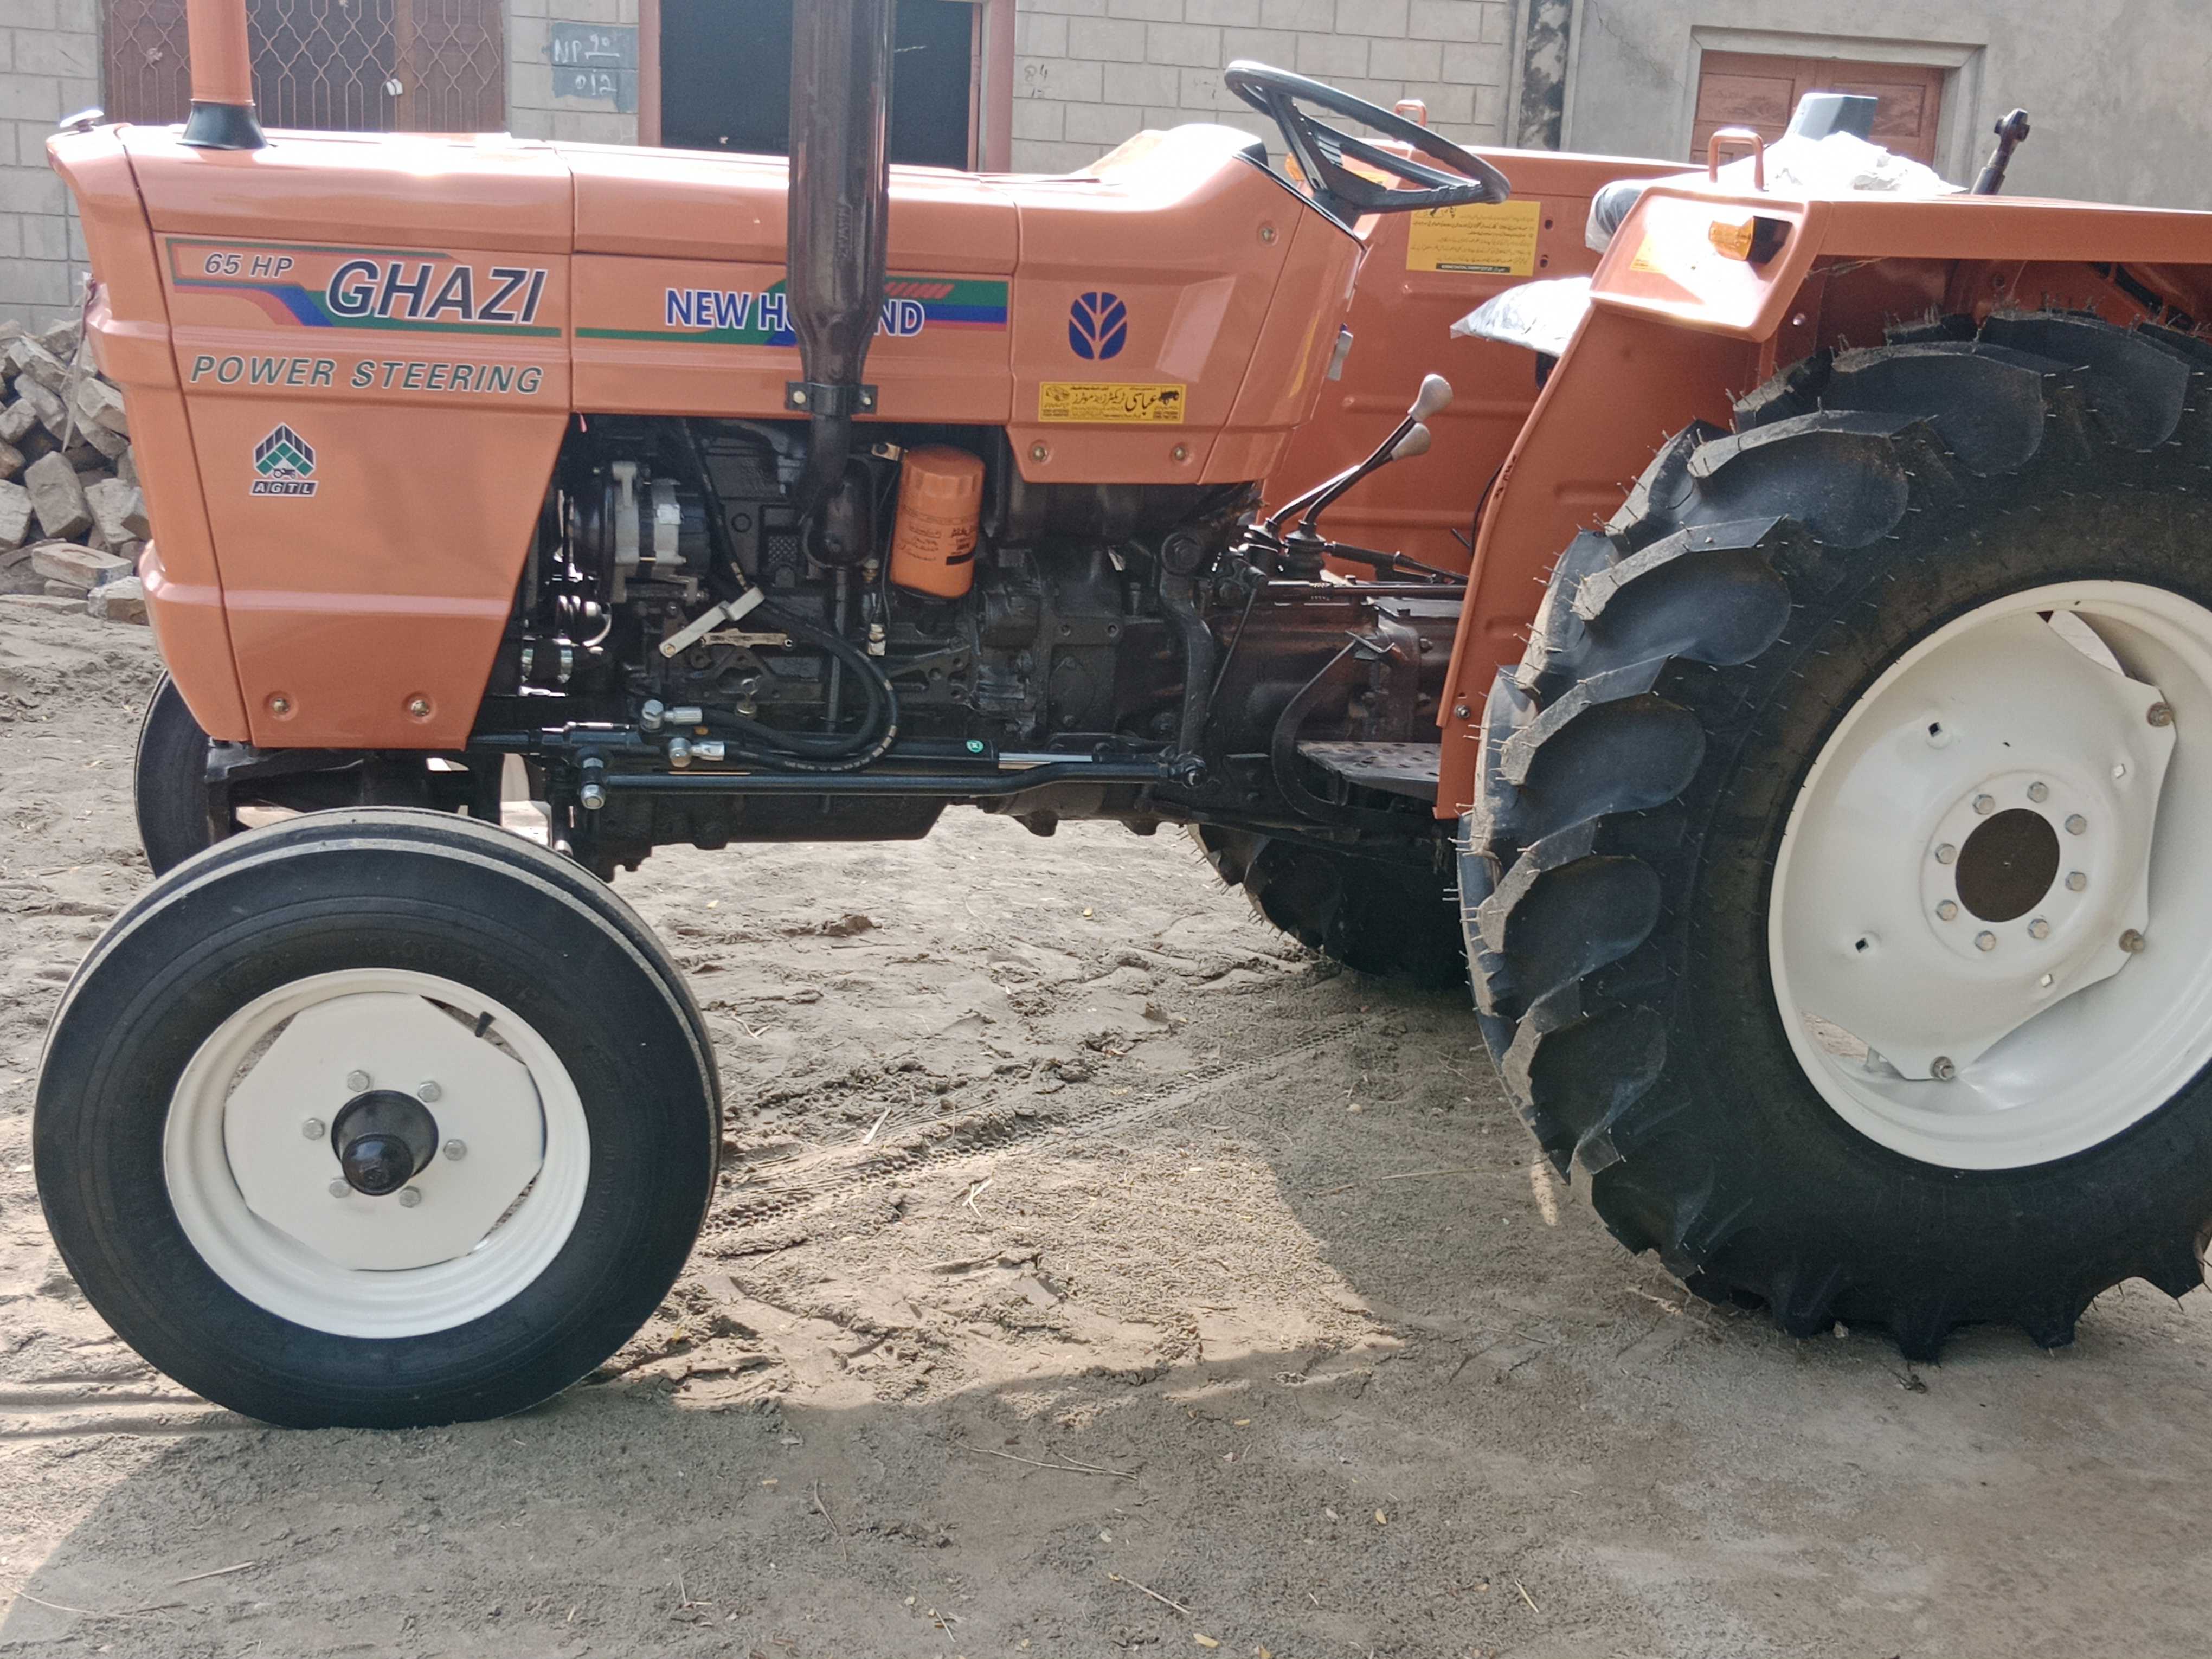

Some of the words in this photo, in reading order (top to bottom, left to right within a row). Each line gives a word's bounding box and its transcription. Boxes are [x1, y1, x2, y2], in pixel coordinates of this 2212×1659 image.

[204, 253, 241, 276] 65
[250, 254, 293, 279] HP
[325, 258, 548, 325] GHAZI
[665, 287, 750, 330] NEW
[190, 354, 337, 388] POWER
[350, 359, 544, 395] STEERING
[253, 482, 312, 494] AGTL
